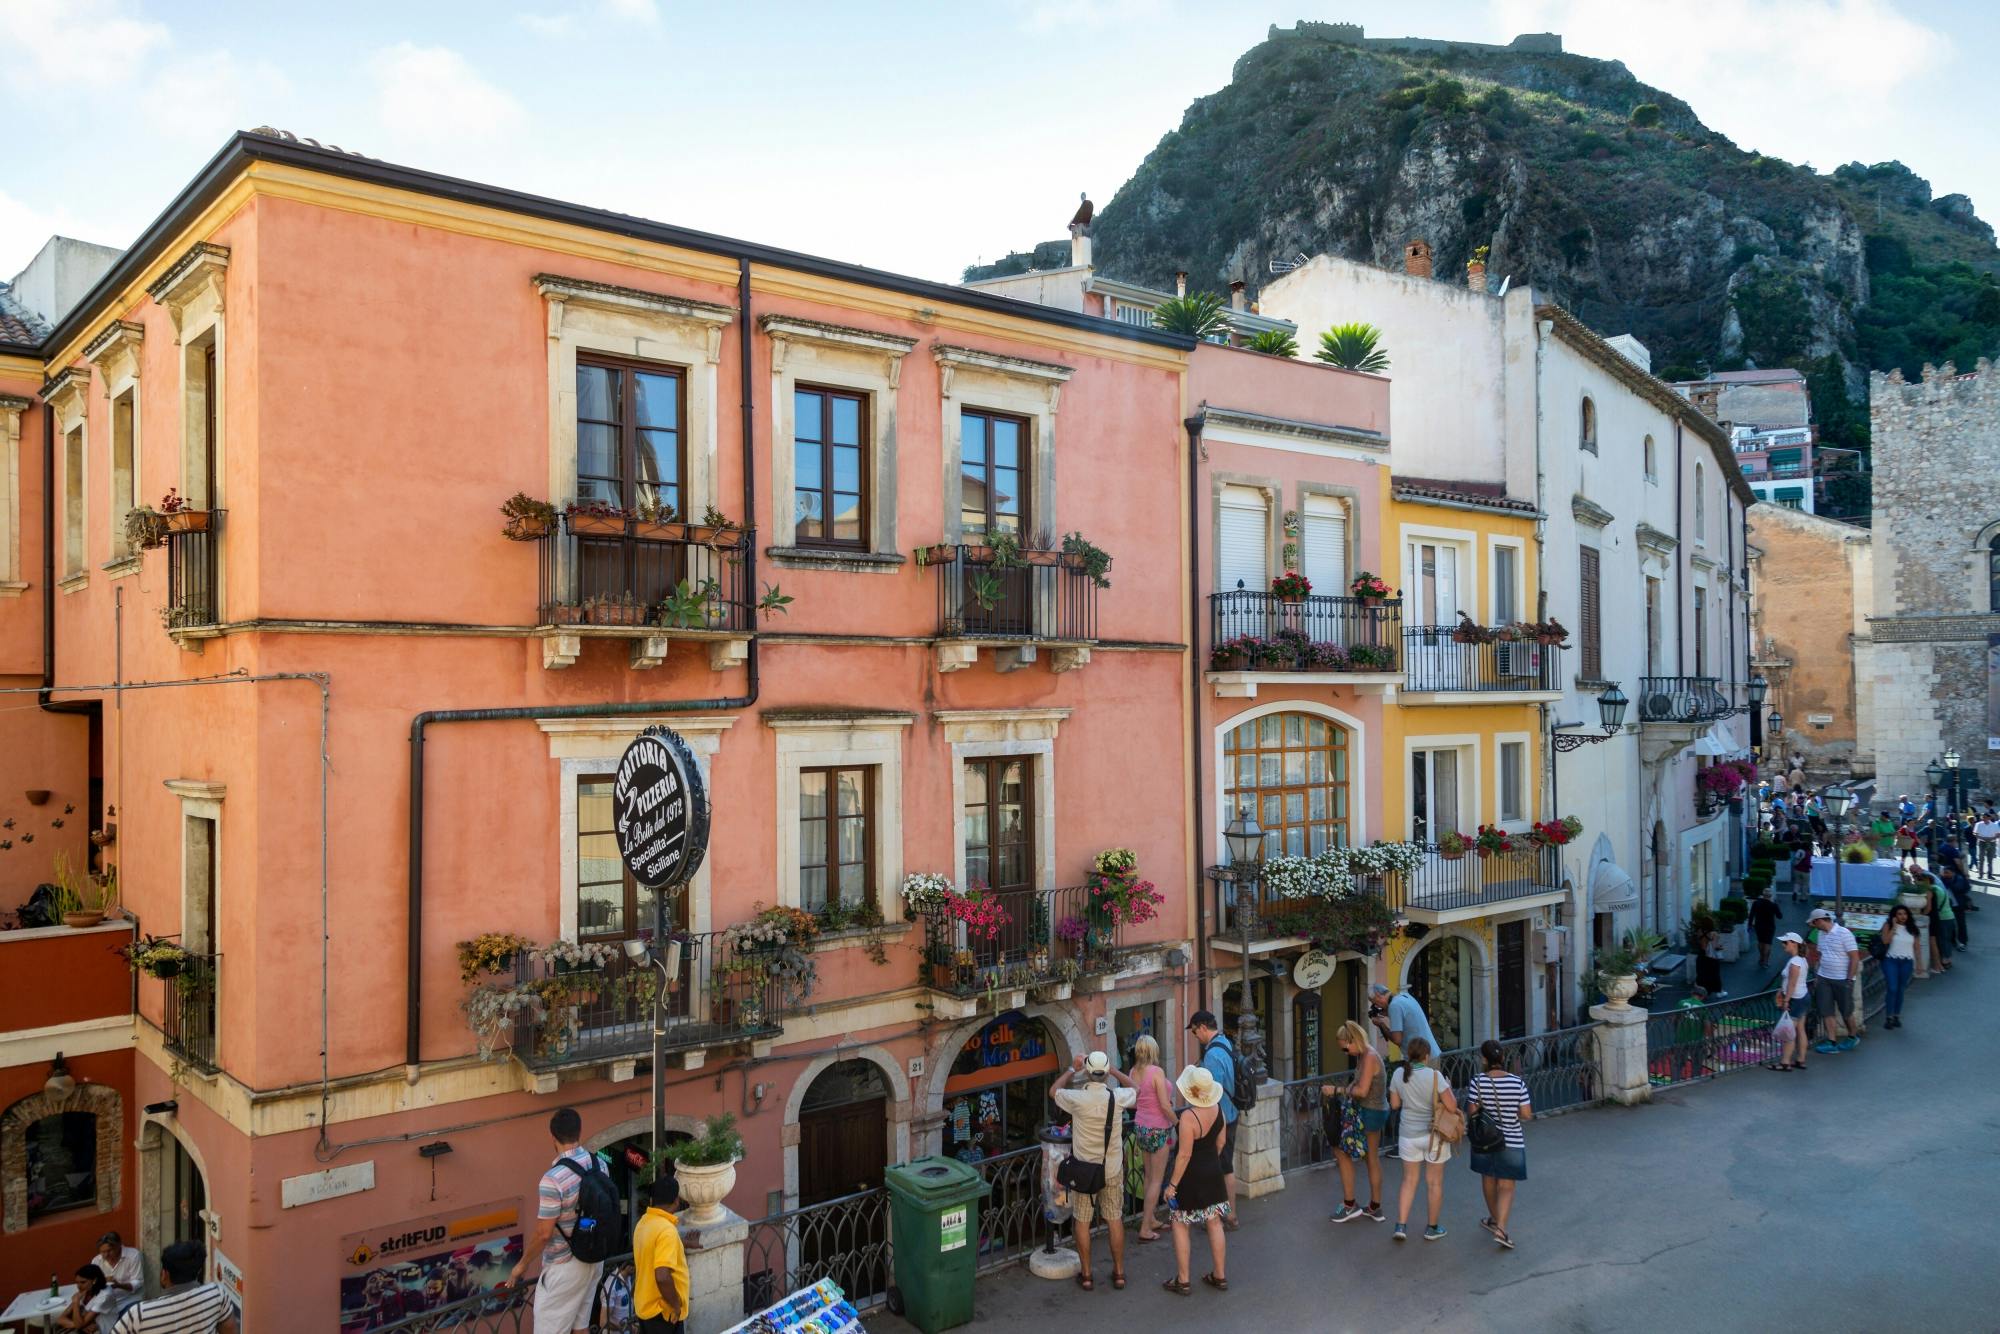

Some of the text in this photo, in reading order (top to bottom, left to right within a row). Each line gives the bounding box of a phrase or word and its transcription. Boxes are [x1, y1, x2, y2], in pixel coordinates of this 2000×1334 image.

[616, 741, 668, 805] TRATTORIA
[636, 771, 678, 816] PIZZERIA
[623, 830, 634, 857] La
[654, 805, 666, 832] dal
[666, 797, 683, 823] 1972
[647, 849, 680, 879] Siciliane
[1098, 1021, 1106, 1030] 19
[912, 1061, 922, 1072] 21
[379, 1226, 446, 1253] stritFUD
